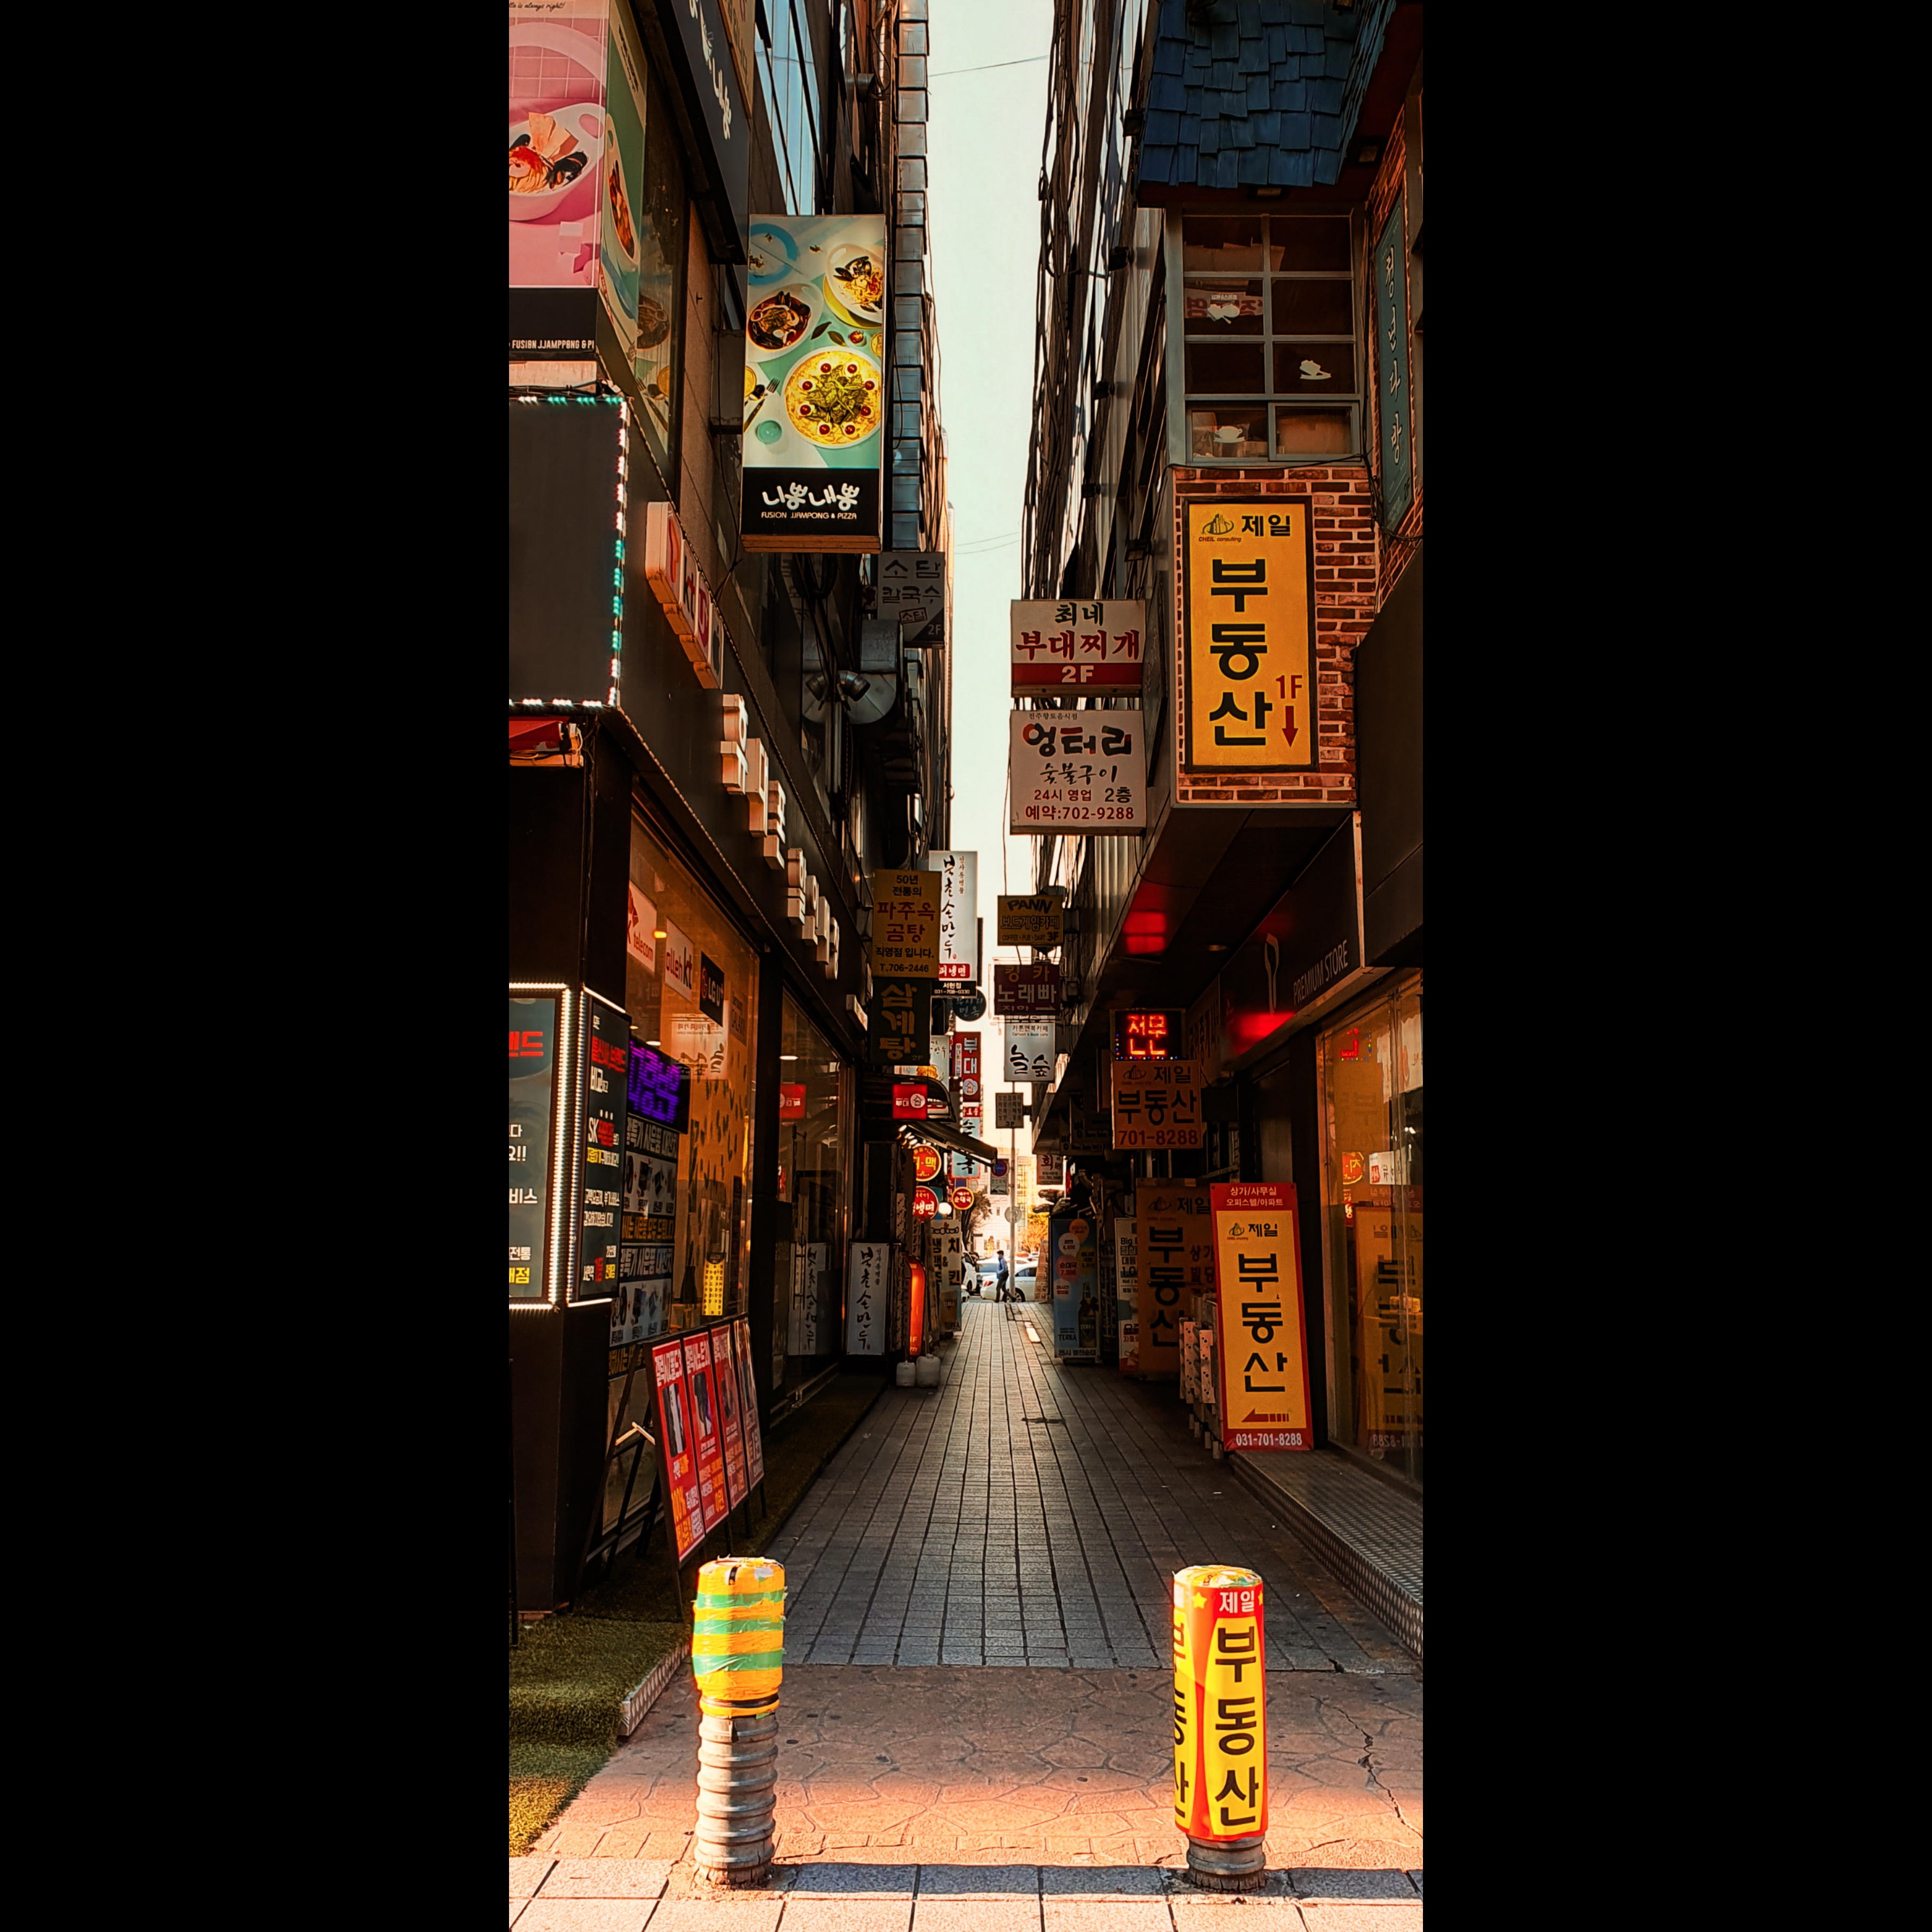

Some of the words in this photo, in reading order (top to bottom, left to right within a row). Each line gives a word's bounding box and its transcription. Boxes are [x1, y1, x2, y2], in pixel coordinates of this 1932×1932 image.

[762, 482, 859, 511] 니뽕내뽕
[1242, 514, 1290, 536] 제일
[883, 559, 941, 578] 소담
[882, 585, 941, 604] 칼국수
[1055, 602, 1104, 627] 최네
[928, 624, 941, 635] 2F
[1015, 629, 1139, 661] 부대찌개
[1209, 559, 1272, 746] 부동산
[1062, 665, 1094, 683] 2F
[1276, 675, 1302, 699] 1F
[1023, 723, 1131, 757] 엉터리
[1040, 762, 1117, 785] 숯불구이
[1034, 789, 1062, 801] 24시
[1068, 789, 1091, 801] 영업
[1105, 787, 1131, 803] 2층
[1026, 805, 1134, 820] 예약:702-9288
[896, 875, 918, 885] 50년
[893, 887, 922, 896] 전통의
[878, 902, 935, 921] 파주옥
[942, 855, 956, 959] 북촌손만두
[1007, 899, 1053, 914] PANN
[886, 924, 925, 943] 곰탕
[1001, 916, 1059, 932] 보드게임카페
[633, 930, 653, 961] telecom
[1047, 932, 1059, 942] 3F
[875, 948, 903, 958] 직영점
[905, 948, 935, 958] 입니다.
[666, 948, 682, 981] olleh
[683, 947, 692, 990] kt
[880, 964, 929, 972] T.706-2446
[1293, 963, 1324, 1006] PREMIUM
[1325, 939, 1348, 982] STORE
[708, 977, 717, 1003] LG
[998, 984, 1057, 1003] 노래빠
[880, 983, 917, 1060] 삼계탕
[1010, 1044, 1051, 1077] 늘숲
[1154, 1066, 1191, 1084] 제일
[1117, 1090, 1196, 1125] 부동산
[1118, 1130, 1198, 1145] 701-8288
[1230, 1186, 1277, 1196] 상가/사무실
[1177, 1198, 1210, 1214] 제일
[1226, 1198, 1284, 1207] 오피스텔/아파트
[1248, 1223, 1278, 1237] 제일
[509, 1247, 531, 1261] 전통
[949, 1238, 960, 1285] 치킨
[857, 1247, 873, 1349] 북촌손만두
[1238, 1253, 1288, 1393] 부동산
[1235, 1433, 1302, 1446] 031-701-8288
[1219, 1590, 1255, 1614] 제일
[1215, 1626, 1259, 1826] 부동산
